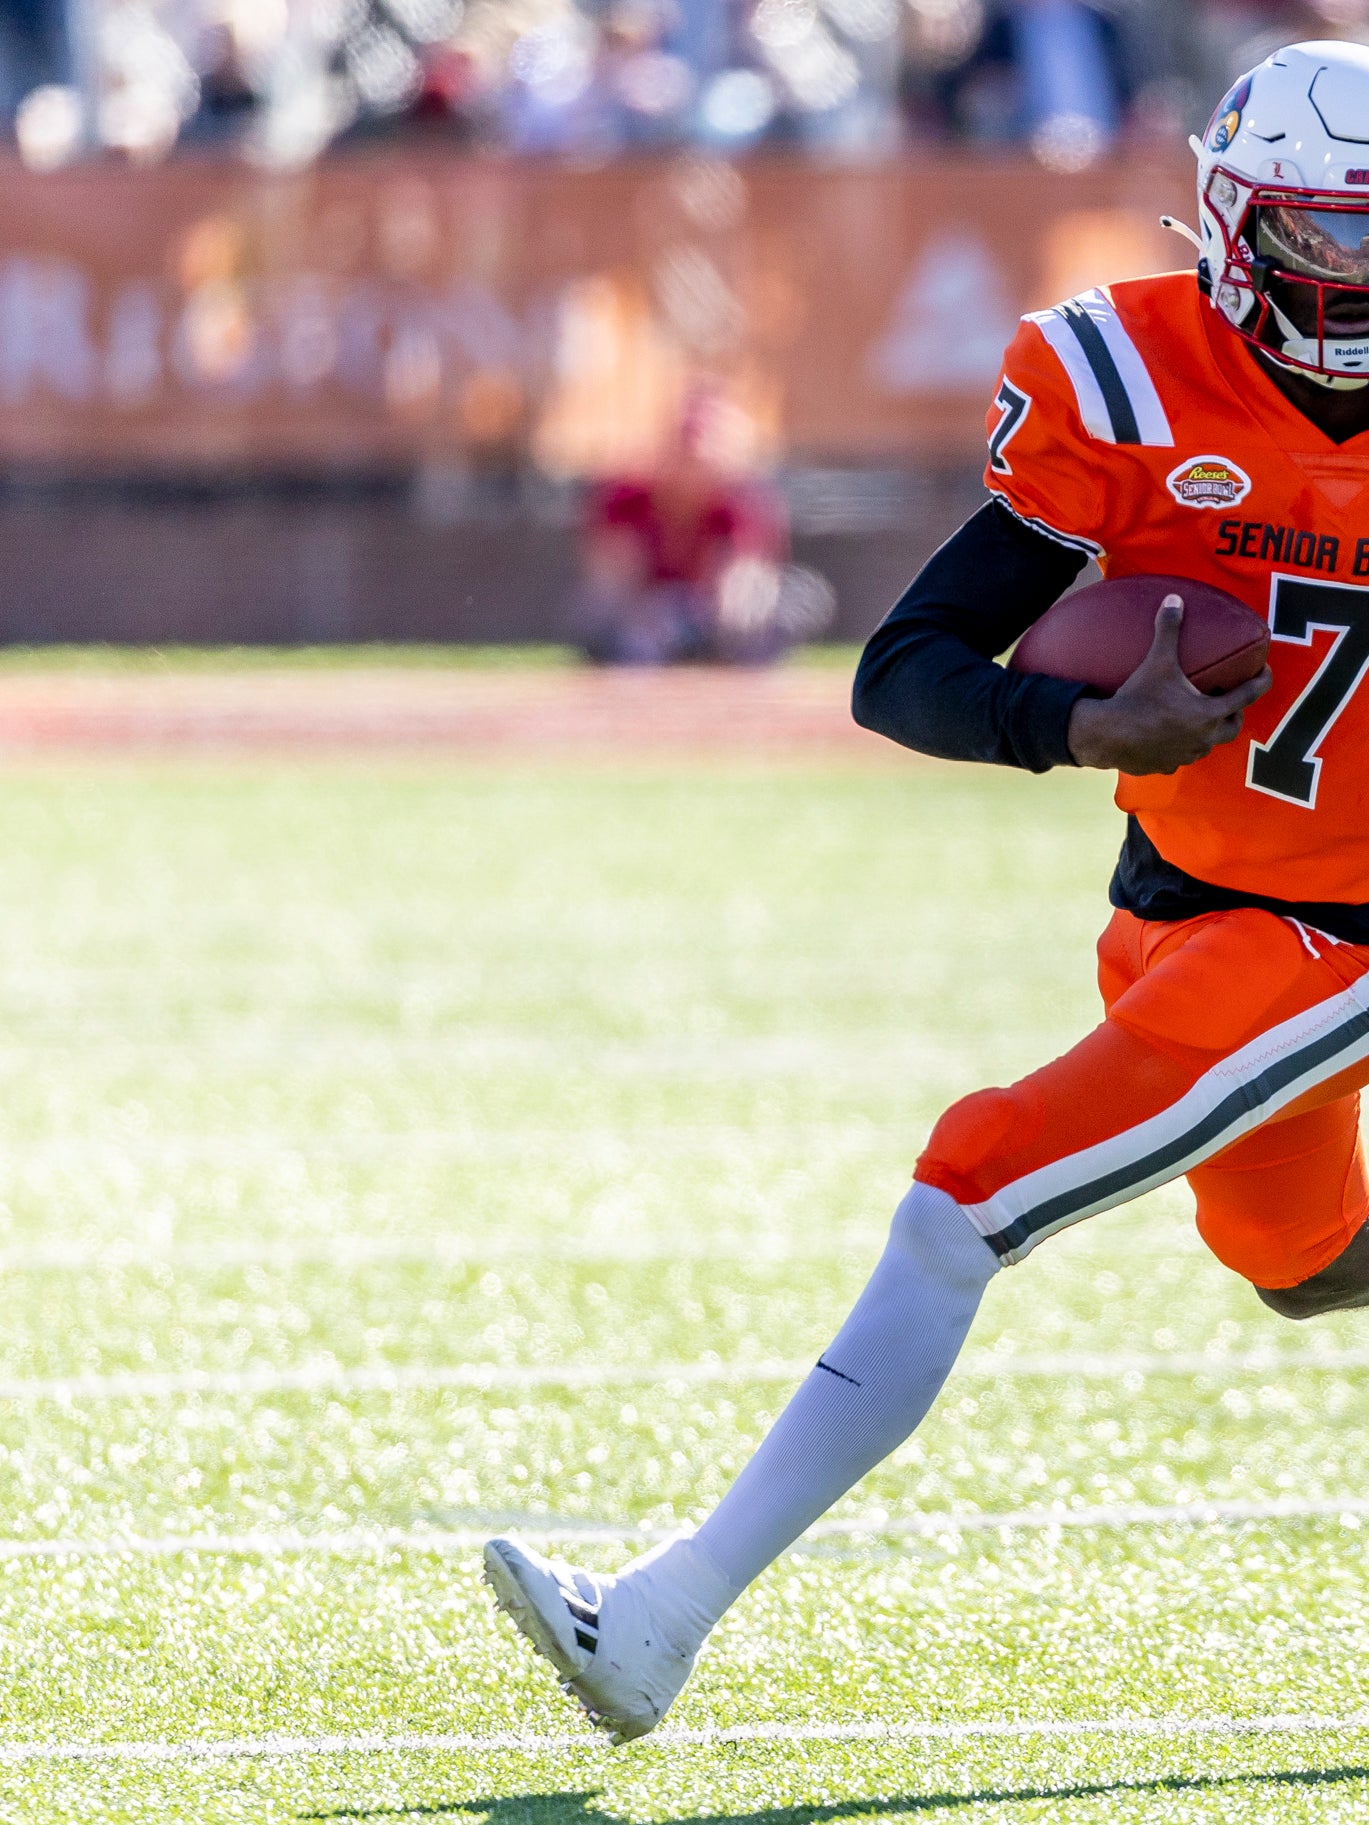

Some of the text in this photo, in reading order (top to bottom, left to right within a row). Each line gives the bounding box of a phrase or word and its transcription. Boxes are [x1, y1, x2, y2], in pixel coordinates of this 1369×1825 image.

[1334, 346, 1369, 356] Riddell
[987, 373, 1032, 476] 7
[1183, 482, 1213, 498] SENIOR
[1215, 520, 1340, 572] SENIOR
